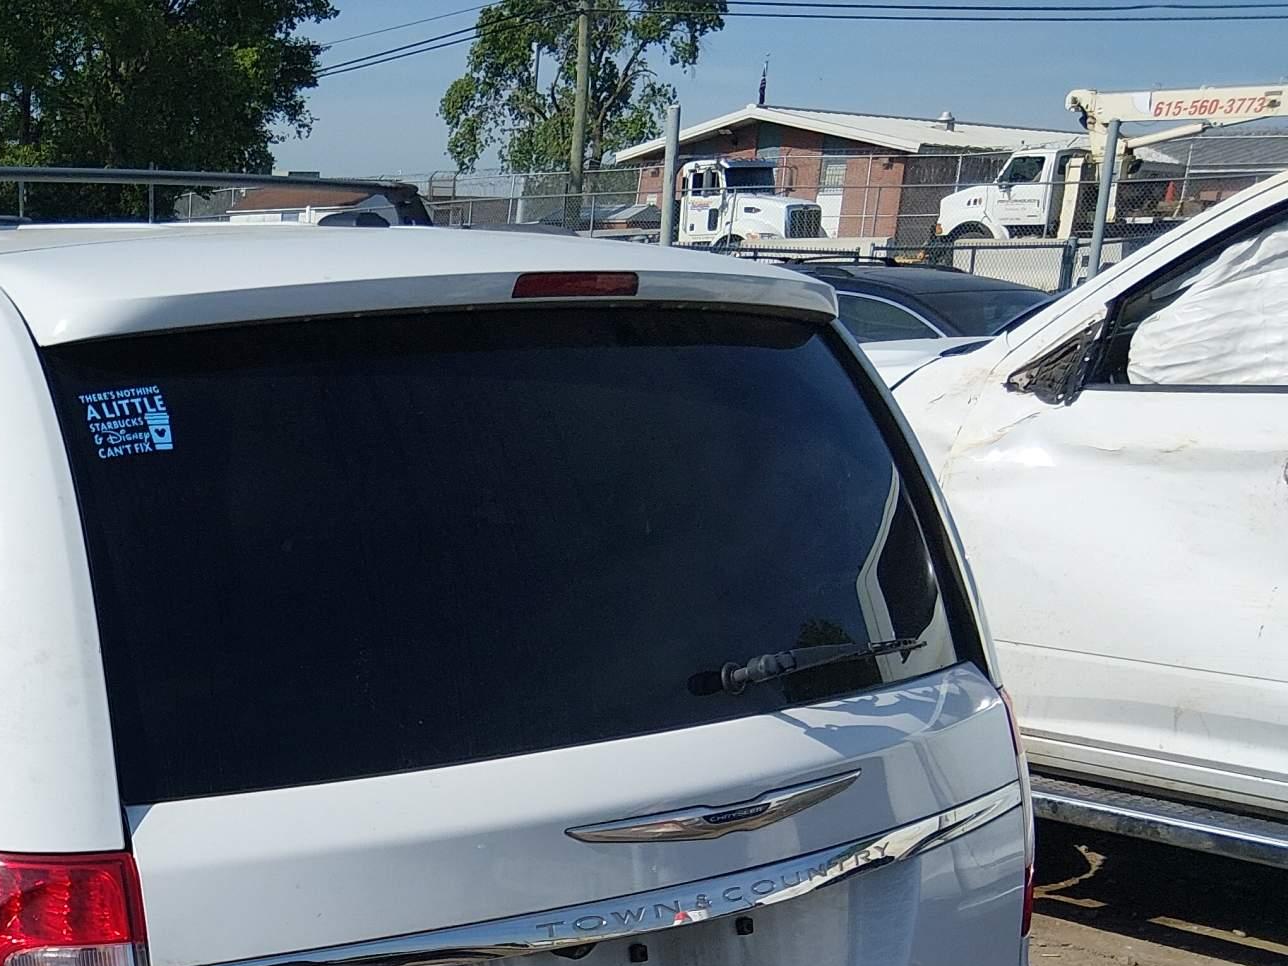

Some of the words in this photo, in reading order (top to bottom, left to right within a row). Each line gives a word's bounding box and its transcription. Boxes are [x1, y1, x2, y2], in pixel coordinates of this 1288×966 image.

[1153, 97, 1266, 117] 615-560-3773
[78, 391, 115, 404] THERE'S
[116, 385, 160, 398] NOTHING
[87, 404, 101, 420] A
[102, 395, 166, 418] LITTLE
[89, 417, 144, 433] STARBUCKS
[98, 444, 132, 459] CAN'T
[134, 442, 153, 454] FIX
[536, 900, 684, 938] TOWN
[696, 893, 713, 909] &
[722, 842, 891, 902] COUNTRY
